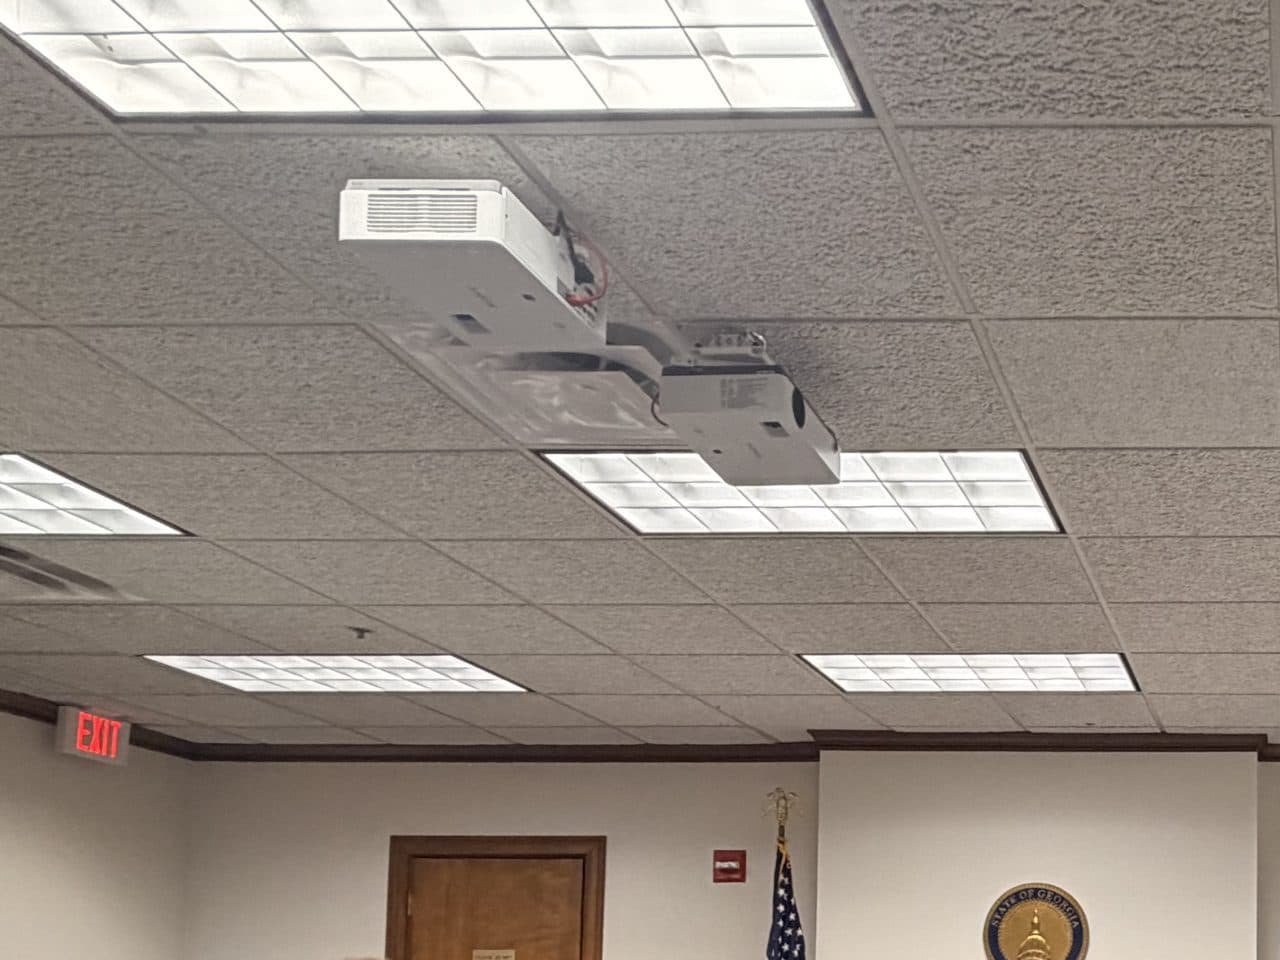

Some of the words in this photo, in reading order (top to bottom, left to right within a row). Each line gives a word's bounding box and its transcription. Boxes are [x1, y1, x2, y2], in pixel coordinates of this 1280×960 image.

[76, 711, 122, 759] EXIT
[991, 894, 1018, 928] STATE
[1019, 889, 1035, 900] OF
[1037, 889, 1080, 929] GEORGIA
